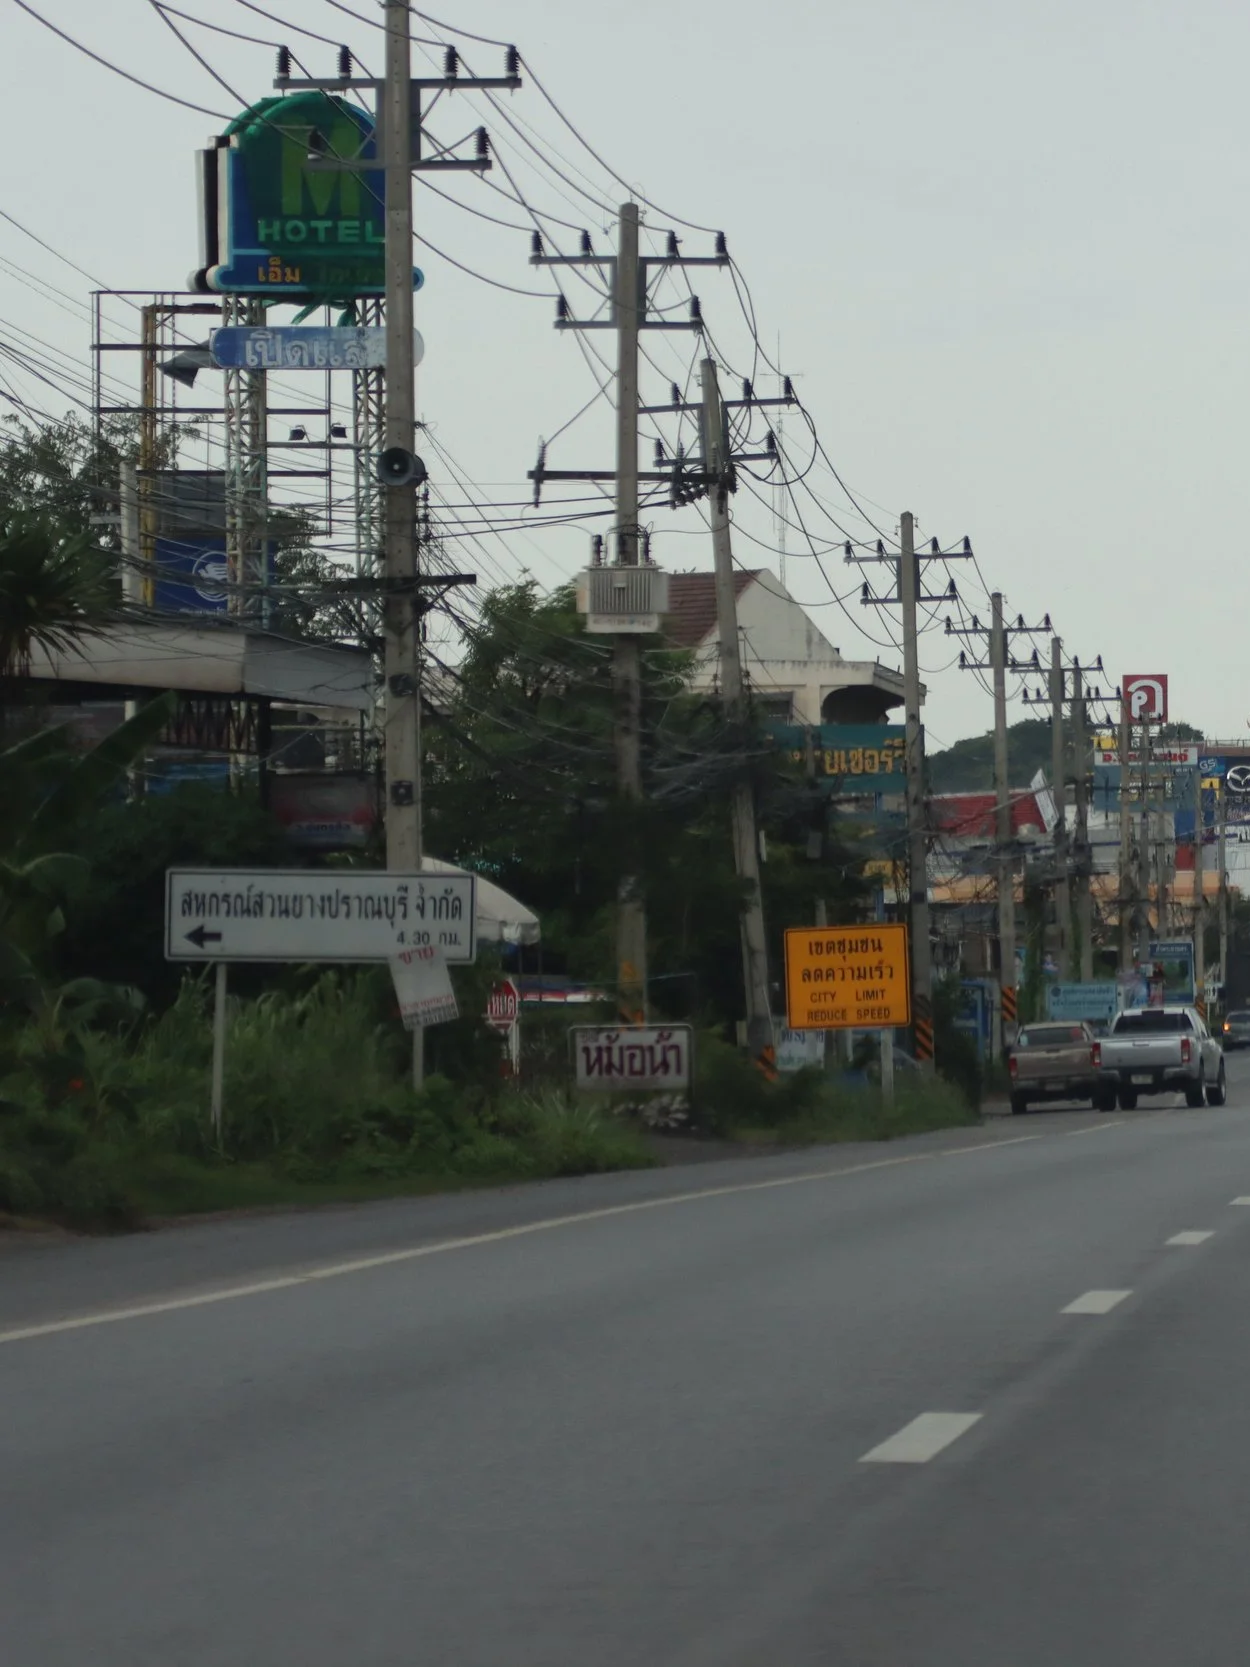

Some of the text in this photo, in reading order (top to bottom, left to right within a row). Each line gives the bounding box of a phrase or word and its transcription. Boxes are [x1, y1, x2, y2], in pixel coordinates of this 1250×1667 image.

[281, 115, 361, 216] M
[258, 219, 386, 243] HOTEL
[396, 931, 430, 945] 4.30
[808, 937, 883, 962] เขตชุมชน
[801, 959, 894, 982] ลดความเร็ว
[810, 989, 886, 1003] CITY LIMIT
[807, 1007, 891, 1023] REDUCE SPEED
